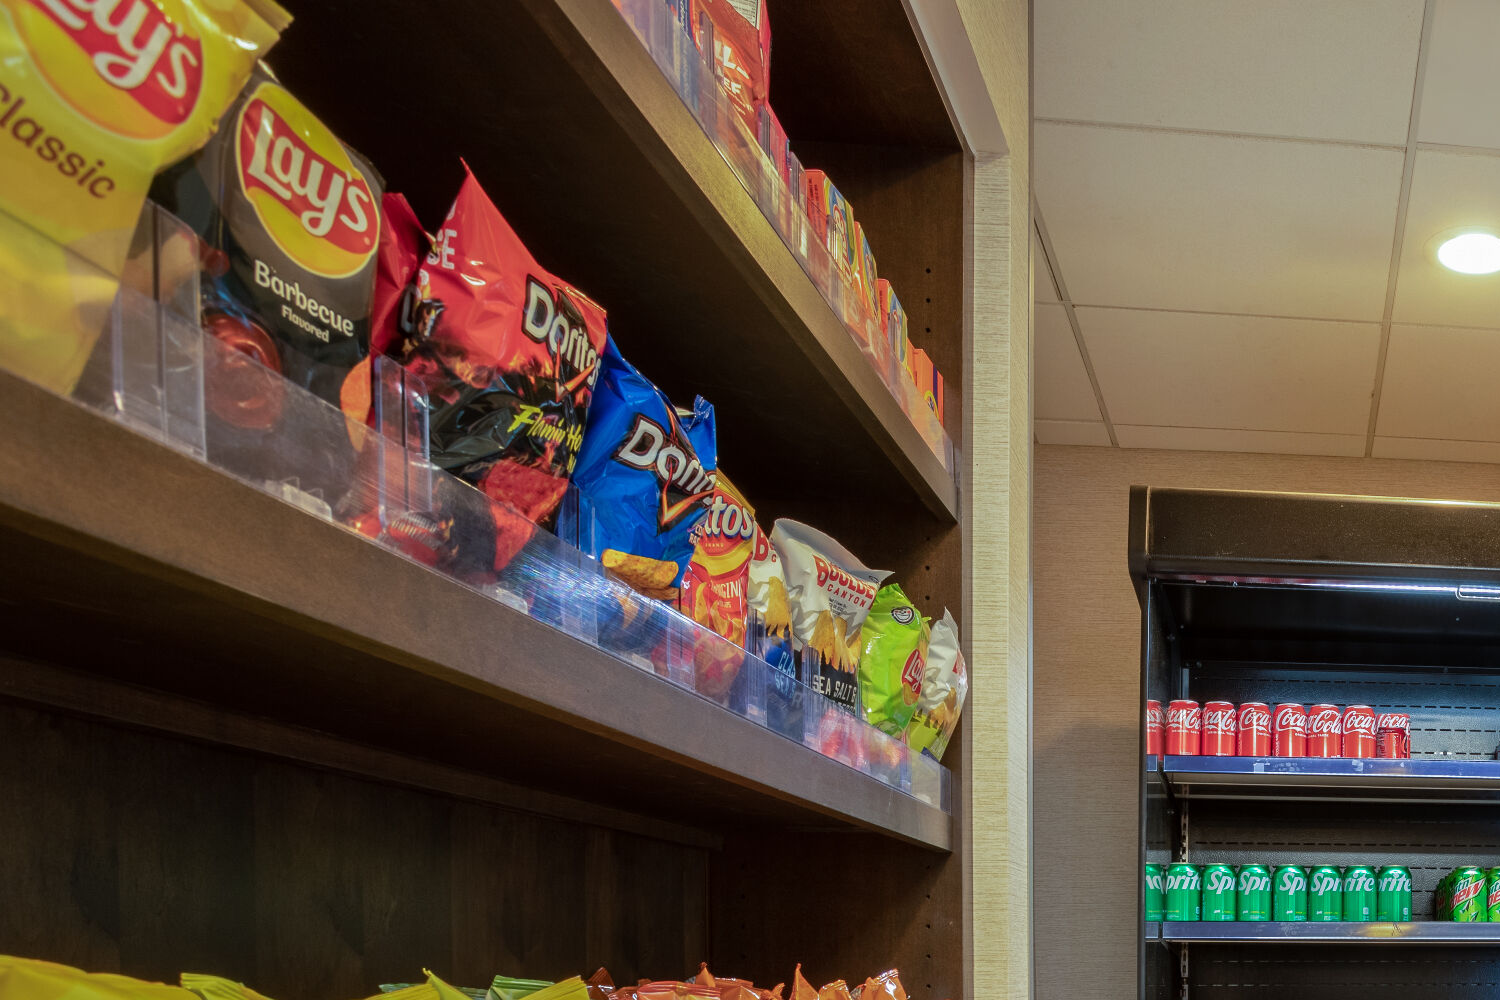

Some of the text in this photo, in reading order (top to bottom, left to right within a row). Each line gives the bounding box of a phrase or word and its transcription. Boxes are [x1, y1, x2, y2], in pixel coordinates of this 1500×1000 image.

[249, 105, 369, 236] Lay's
[254, 259, 354, 336] Barbecue
[281, 304, 330, 342] Flavored
[827, 583, 867, 608] CANYON
[812, 674, 832, 696] SEA
